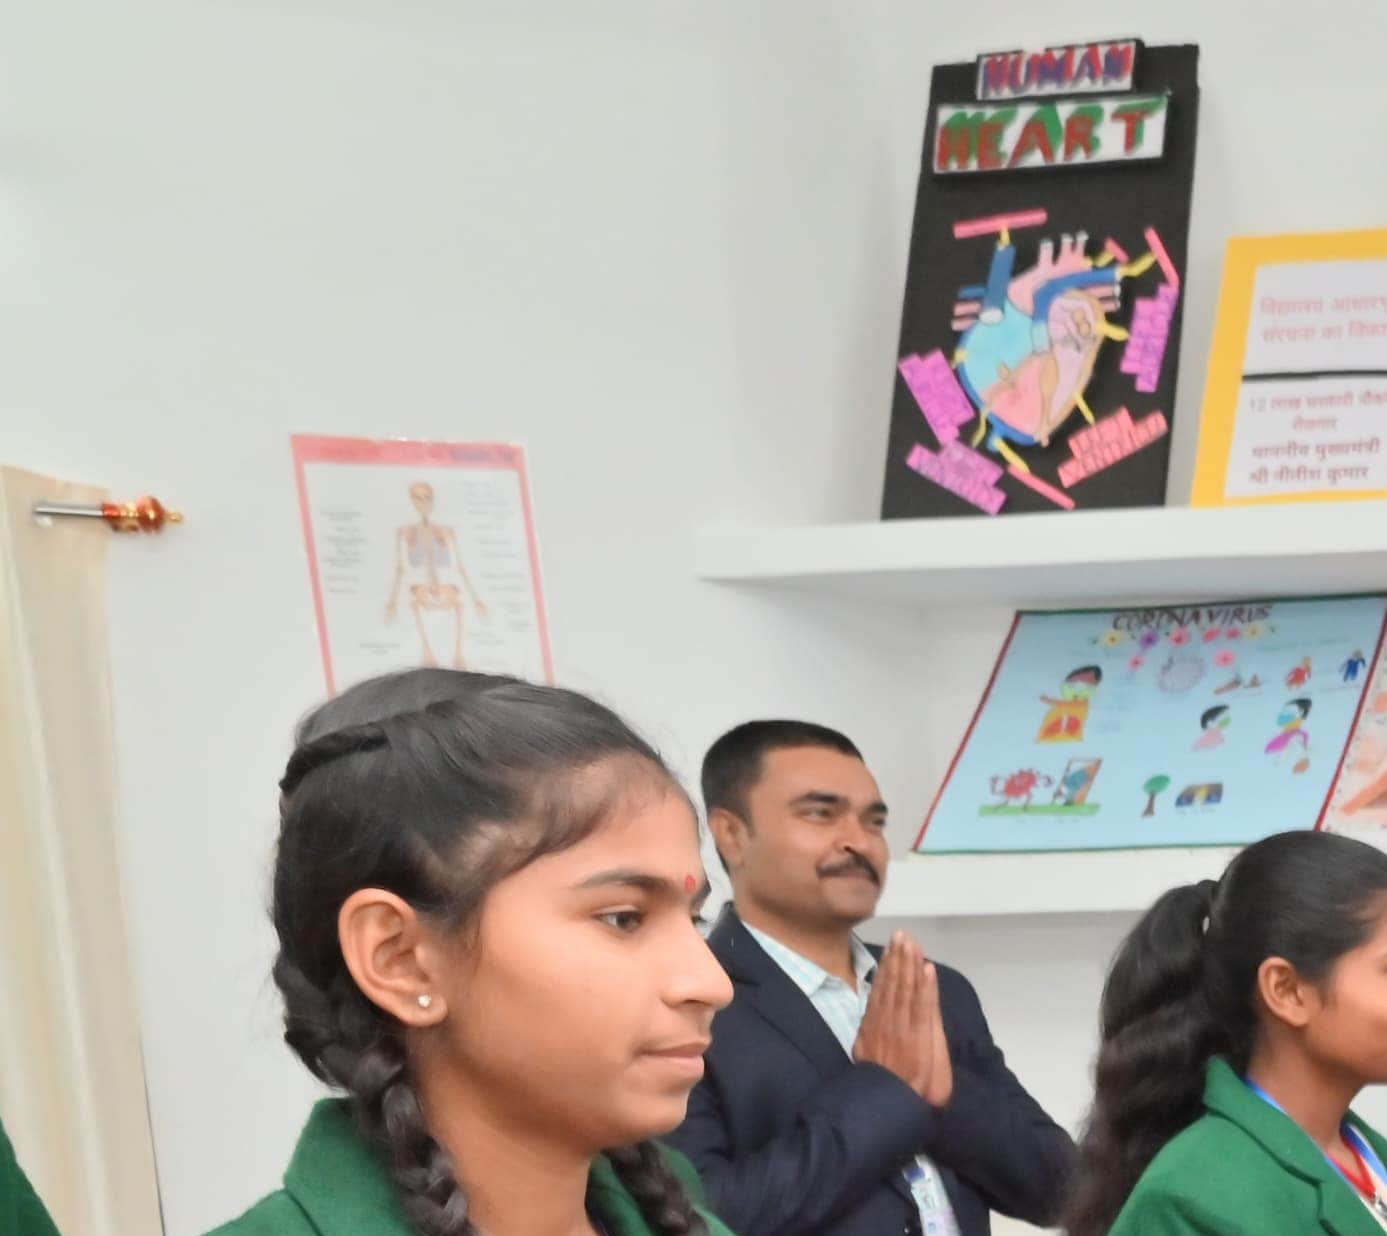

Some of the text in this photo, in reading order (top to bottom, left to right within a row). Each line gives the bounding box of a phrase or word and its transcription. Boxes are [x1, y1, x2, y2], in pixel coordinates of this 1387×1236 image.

[982, 43, 1132, 94] HUMAN
[938, 97, 1167, 171] HEART
[1328, 465, 1369, 485] कुमार
